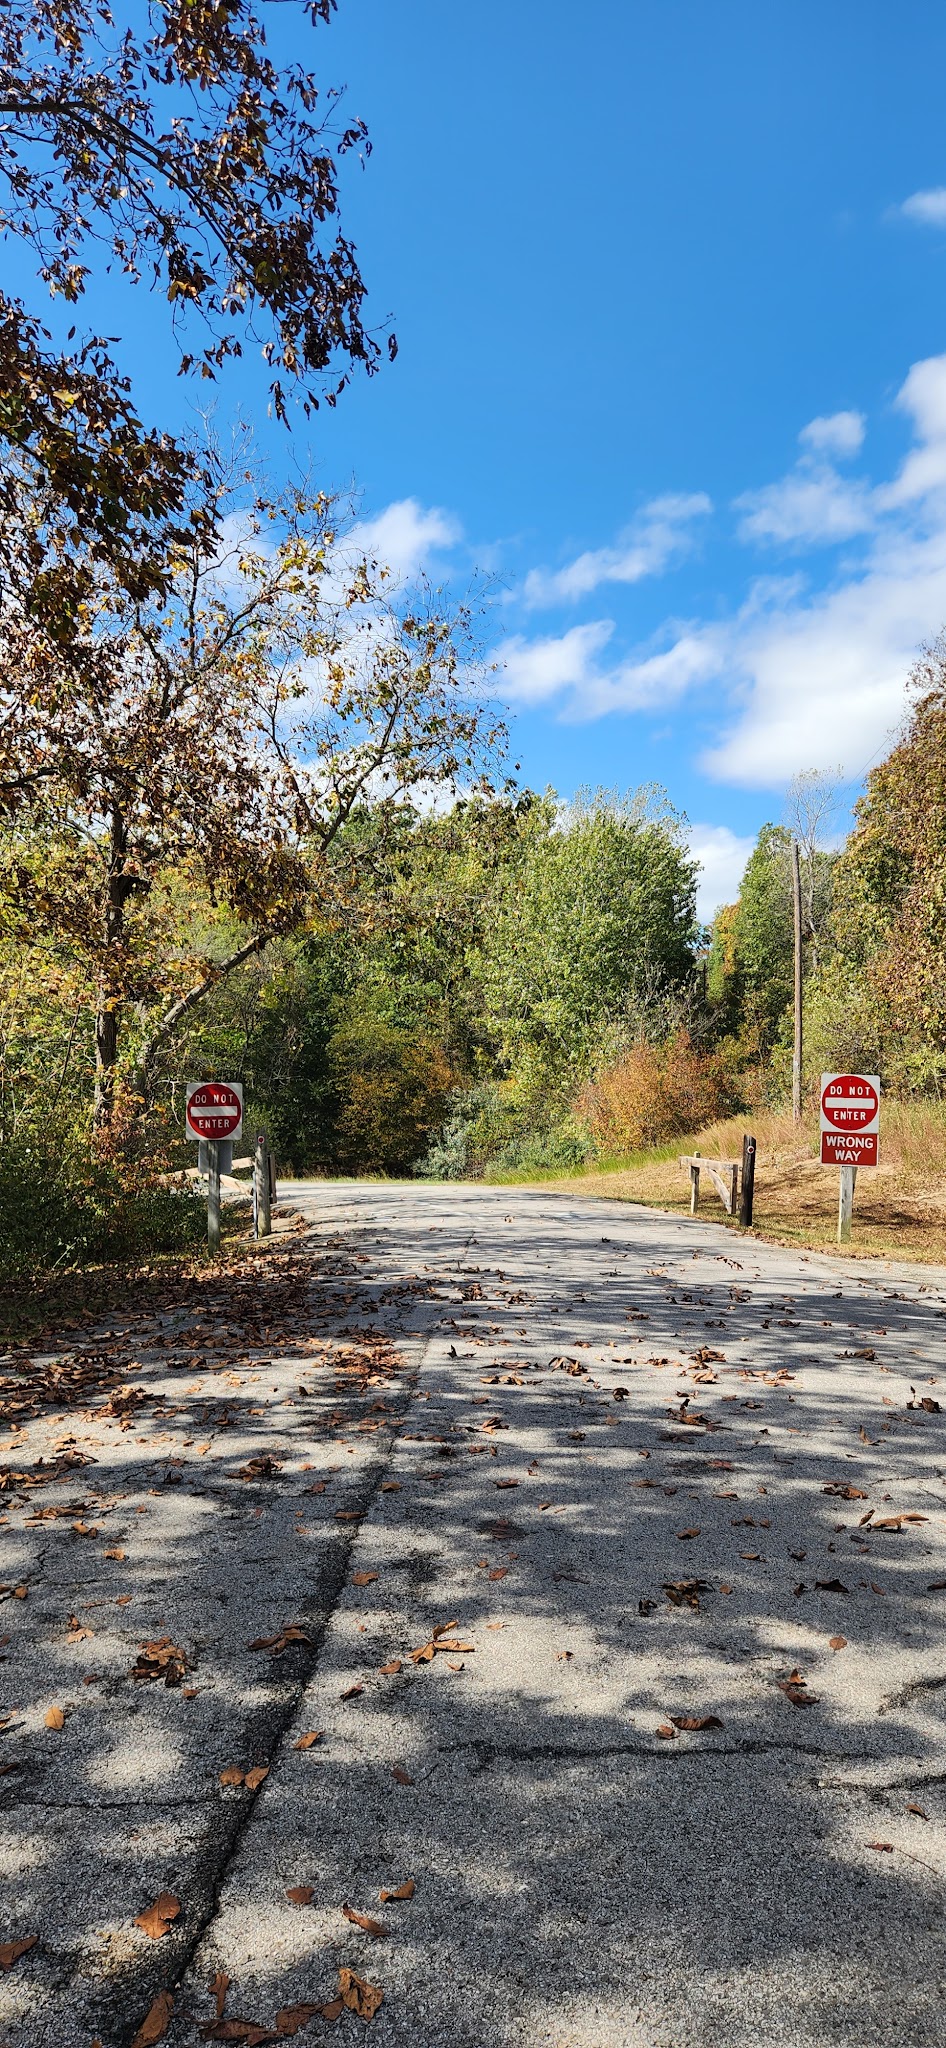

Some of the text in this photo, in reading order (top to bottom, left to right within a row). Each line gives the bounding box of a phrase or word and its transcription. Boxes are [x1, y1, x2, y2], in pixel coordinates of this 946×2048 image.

[830, 1086, 870, 1096] DO NOT
[195, 1094, 233, 1103] DO NOT
[834, 1111, 866, 1120] ENTER
[199, 1119, 230, 1128] ENTER
[826, 1136, 874, 1149] WRONG
[835, 1150, 861, 1161] WAY
